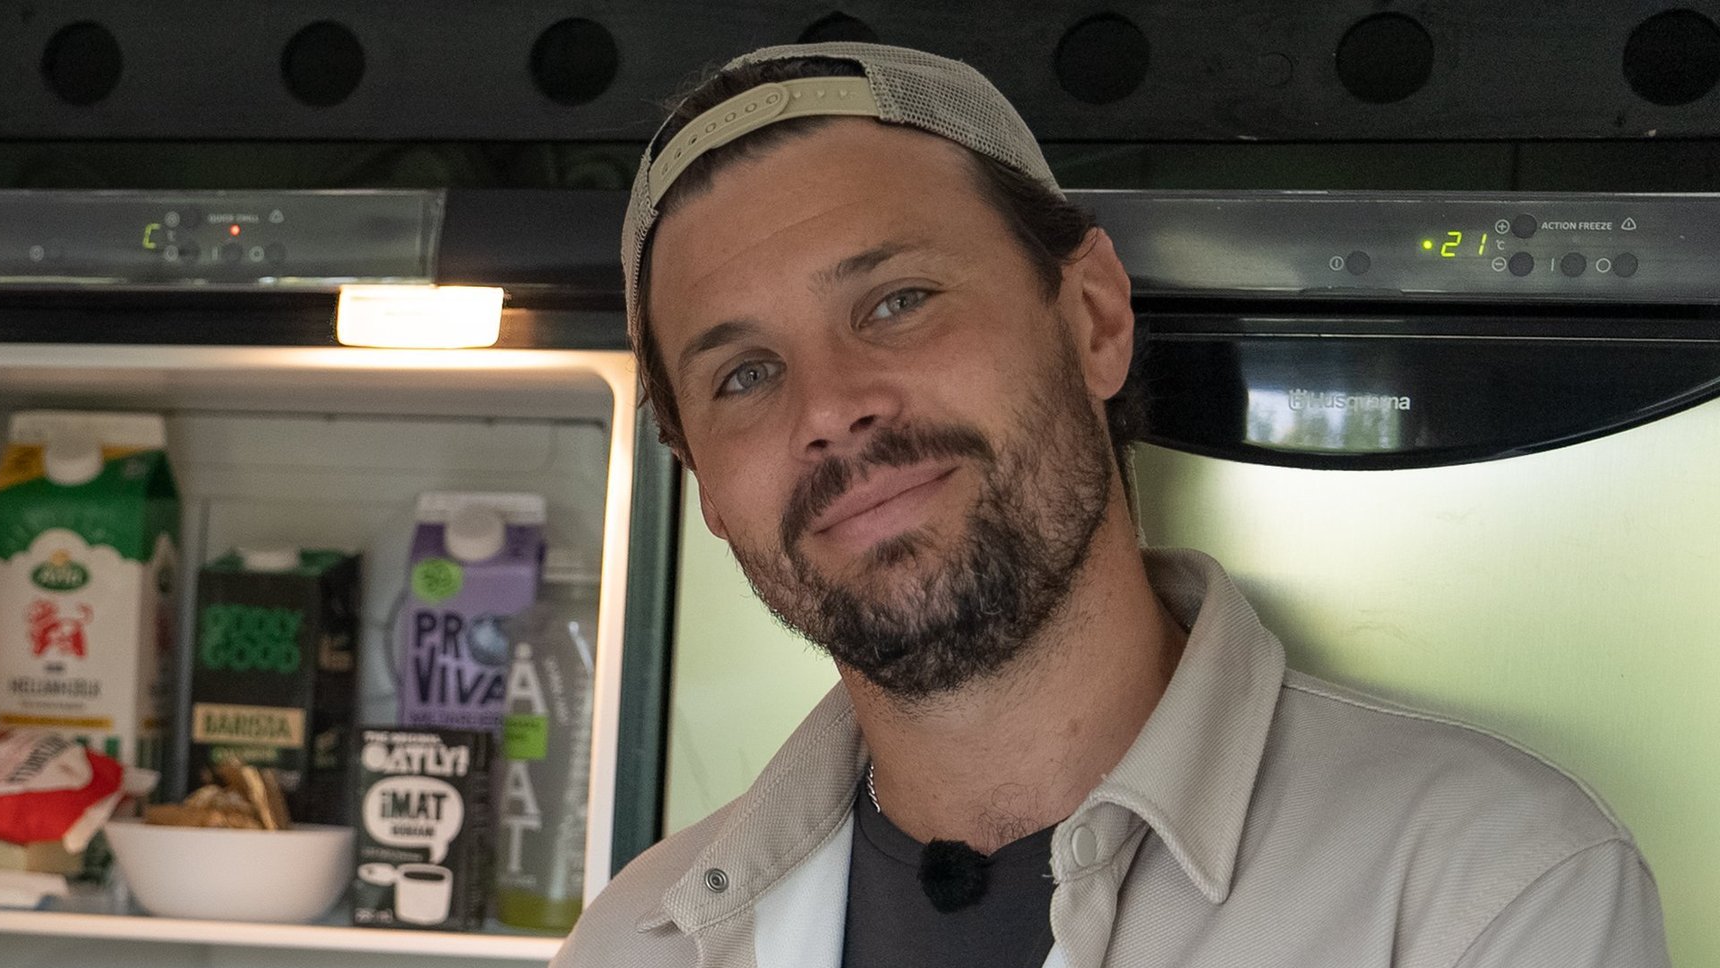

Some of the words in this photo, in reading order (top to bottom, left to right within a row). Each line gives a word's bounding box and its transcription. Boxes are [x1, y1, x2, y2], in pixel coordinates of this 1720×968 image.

[1541, 221, 1577, 231] ACTION
[1579, 222, 1613, 231] FREEZE
[1308, 391, 1411, 412] Husqvarna
[204, 714, 292, 738] BARISTA
[361, 742, 470, 777] OATLY!
[381, 790, 449, 820] iMAT
